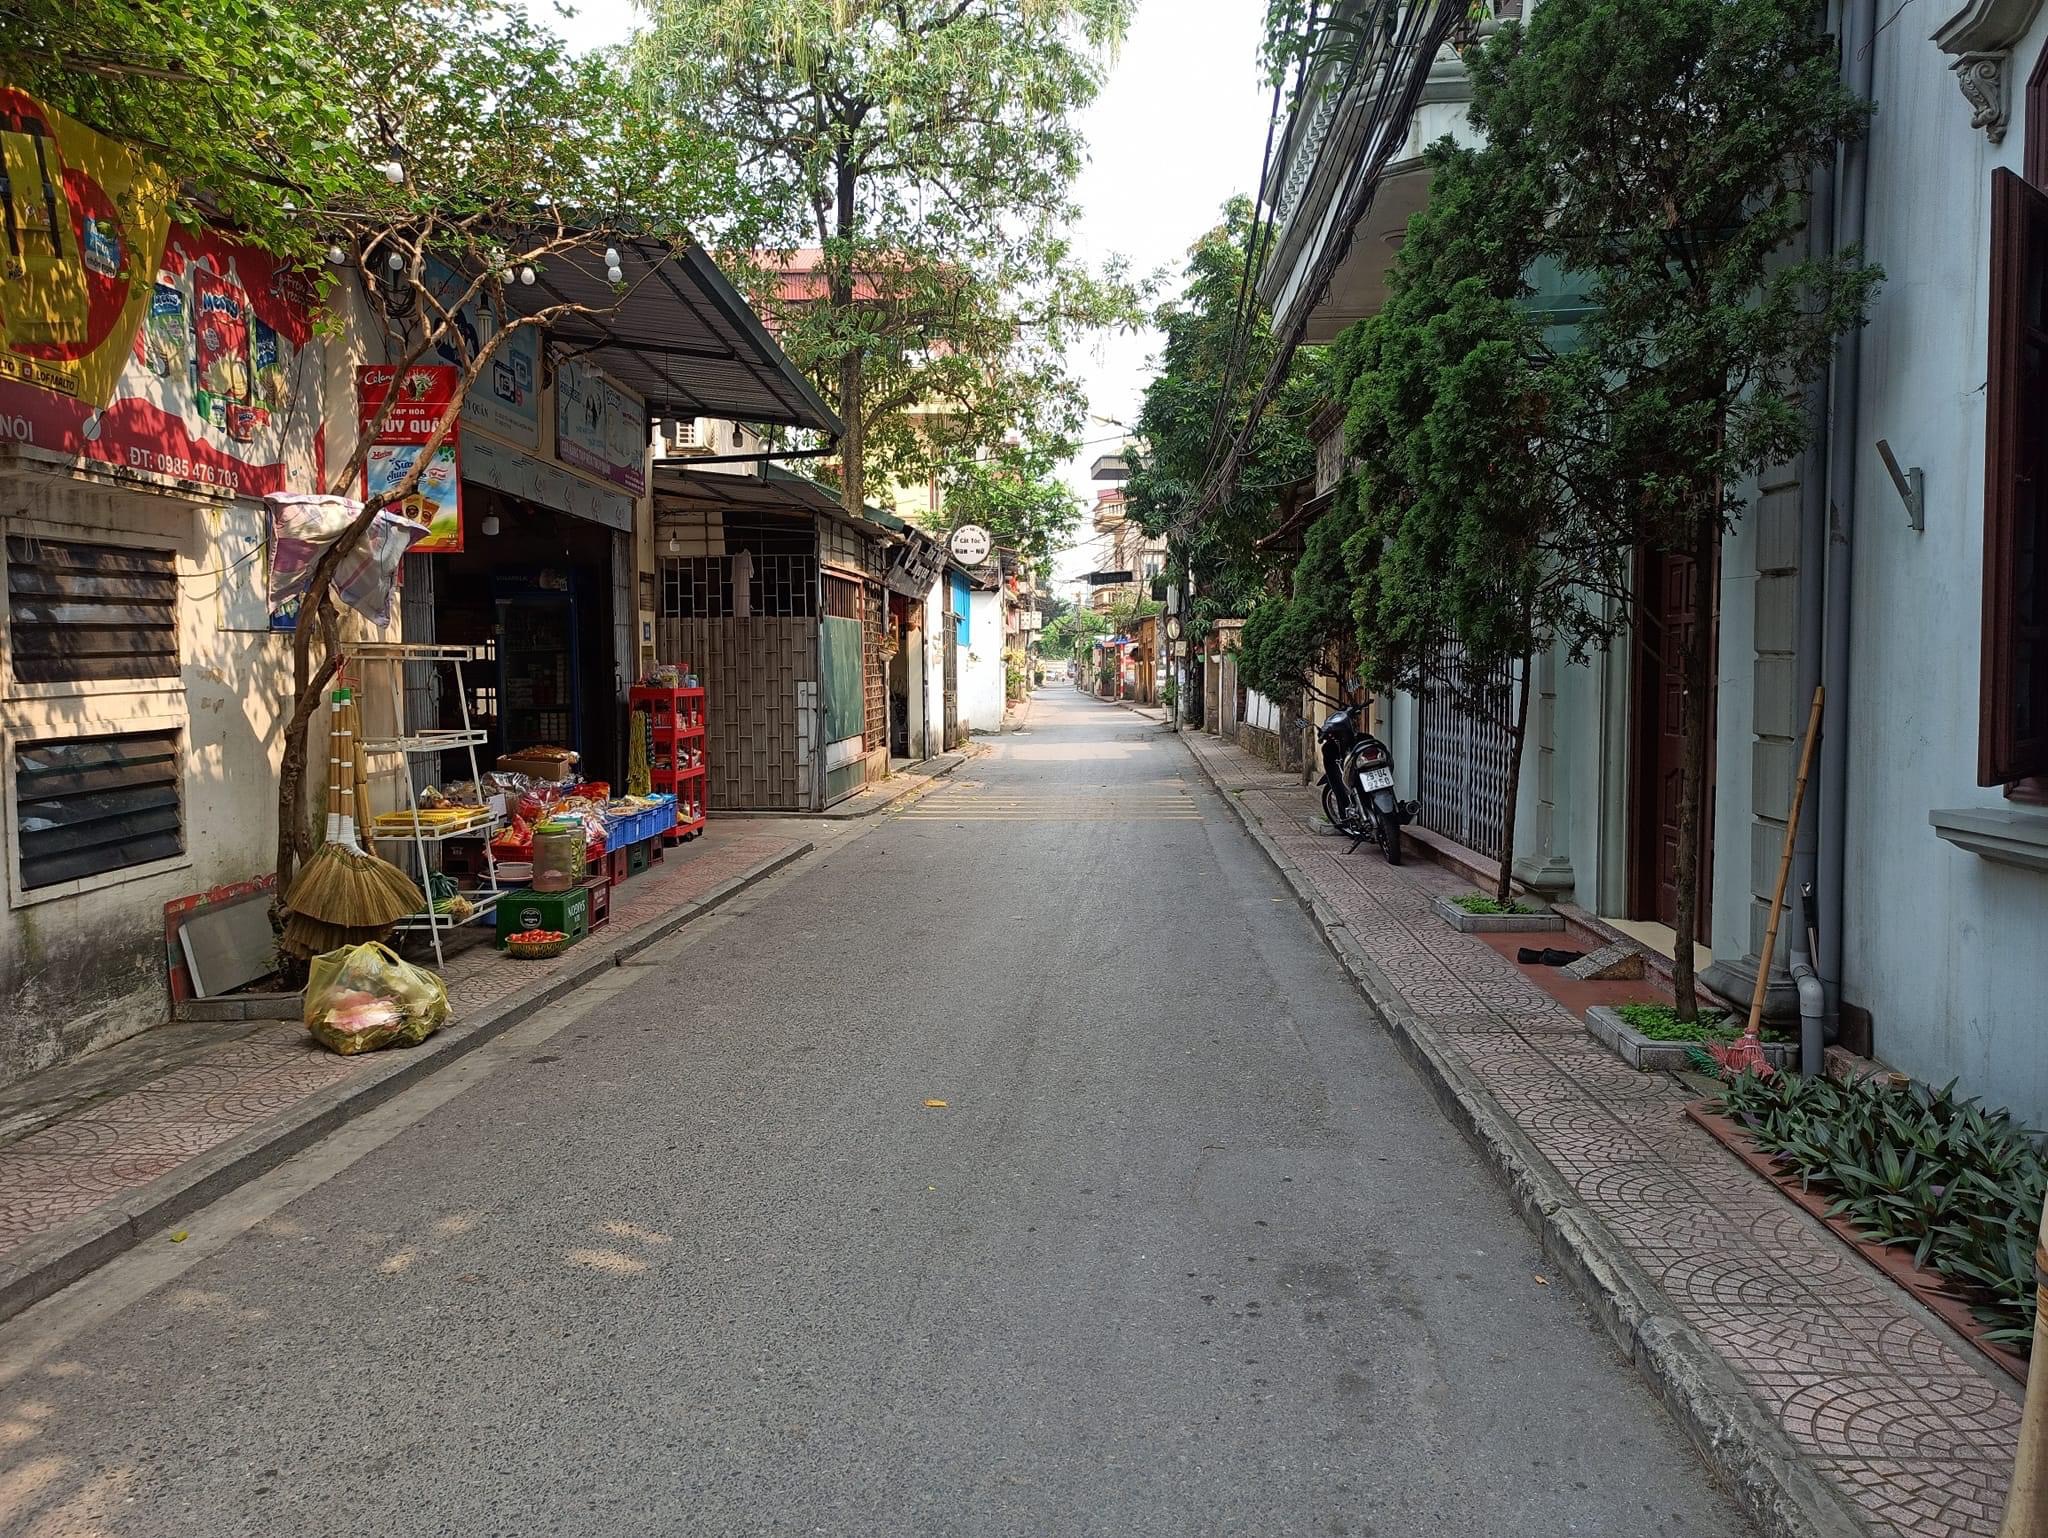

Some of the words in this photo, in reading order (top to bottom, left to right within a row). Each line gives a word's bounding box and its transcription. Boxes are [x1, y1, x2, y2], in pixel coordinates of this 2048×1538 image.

[129, 446, 154, 469] ĐT:
[157, 453, 189, 477] 0985
[192, 463, 215, 482] 476
[217, 468, 239, 488] 703
